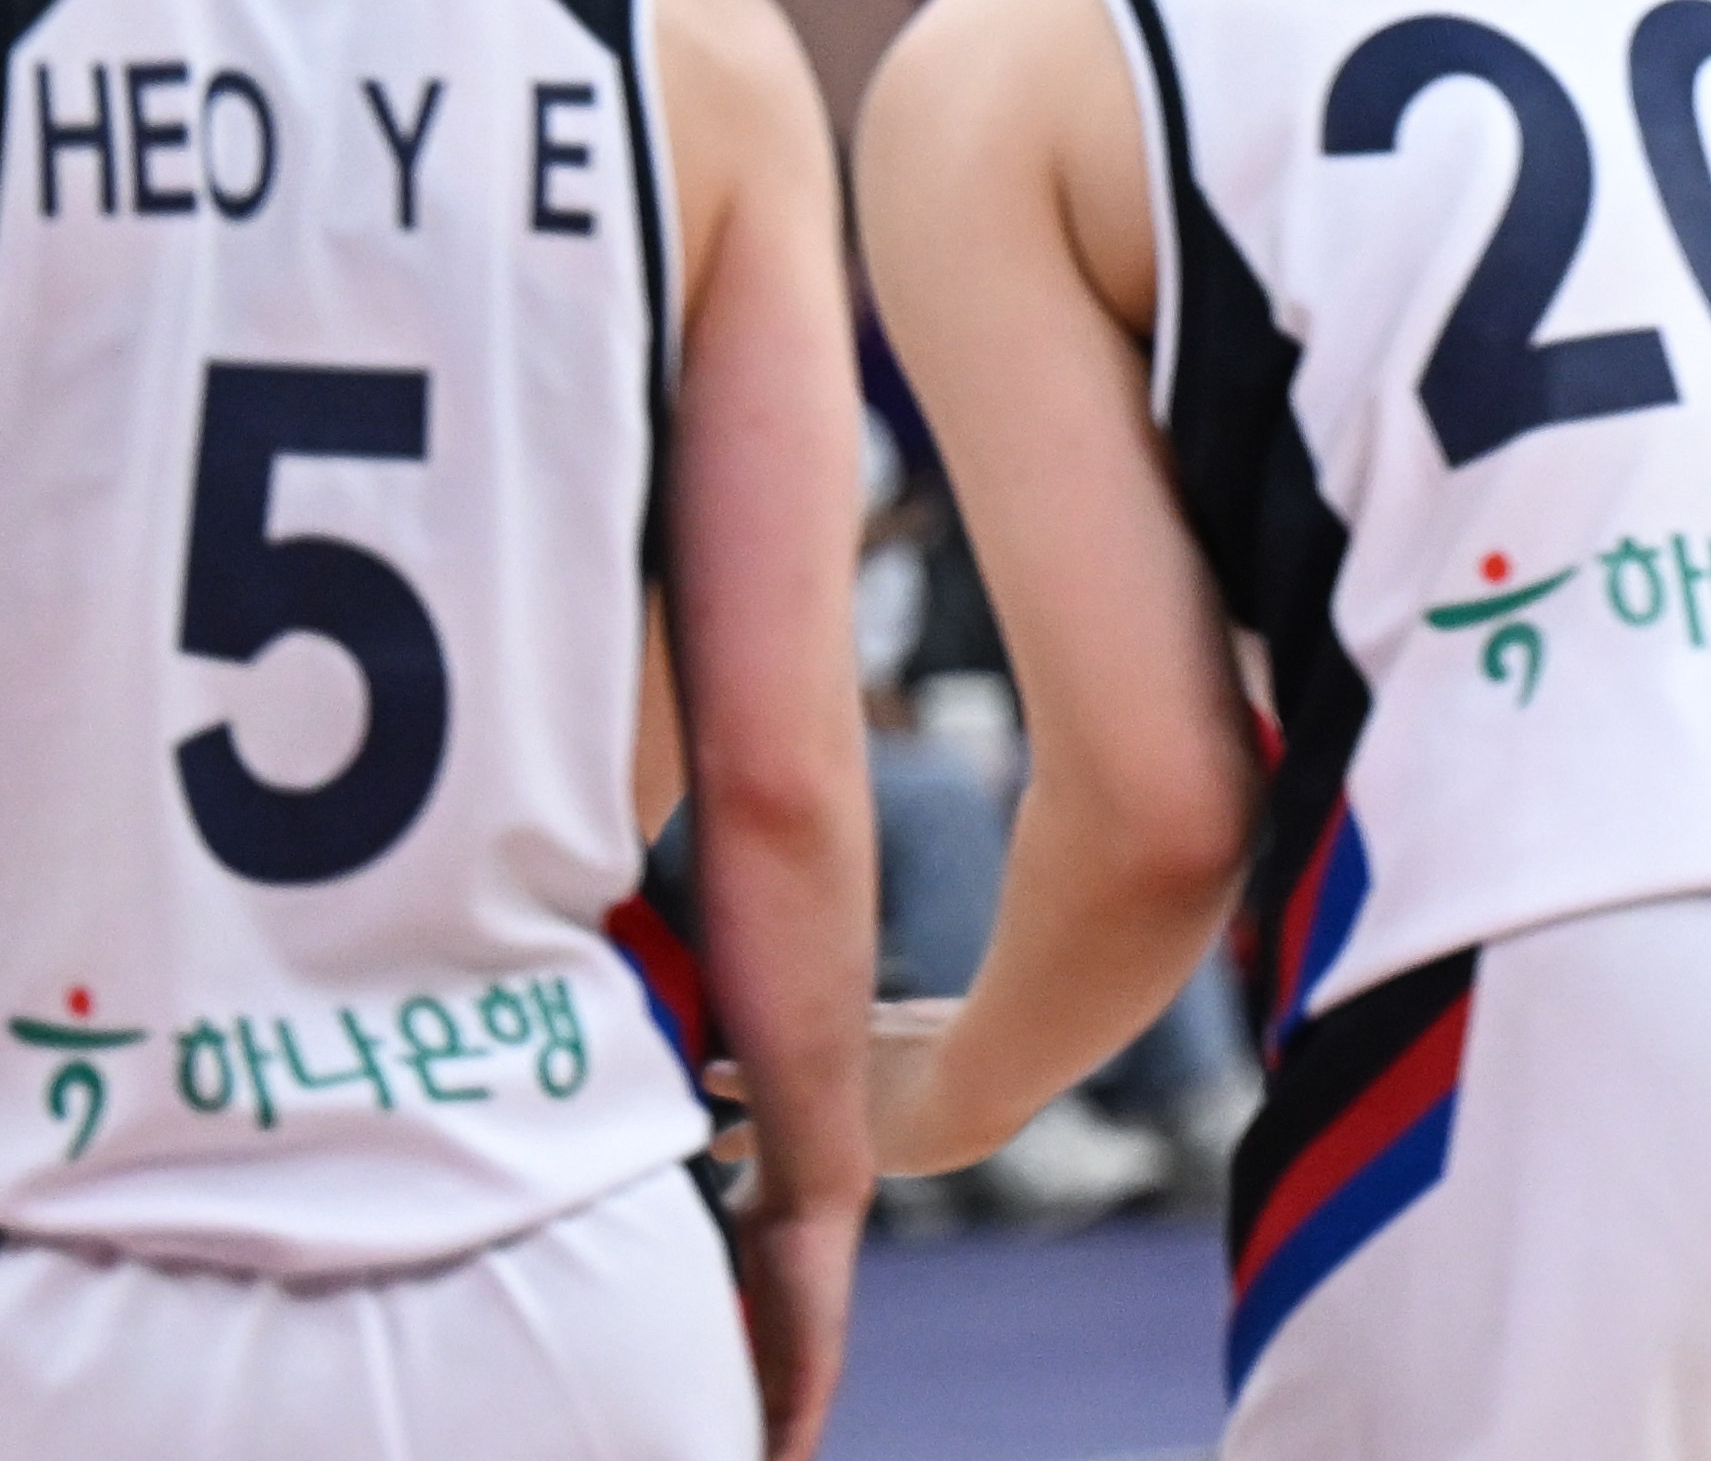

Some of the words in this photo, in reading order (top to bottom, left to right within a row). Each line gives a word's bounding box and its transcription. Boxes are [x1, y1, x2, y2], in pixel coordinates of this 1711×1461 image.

[33, 59, 278, 223] HEO
[359, 75, 445, 231] Y
[529, 81, 597, 237] E
[176, 362, 450, 886] 5
[173, 974, 589, 1132] 하나은행
